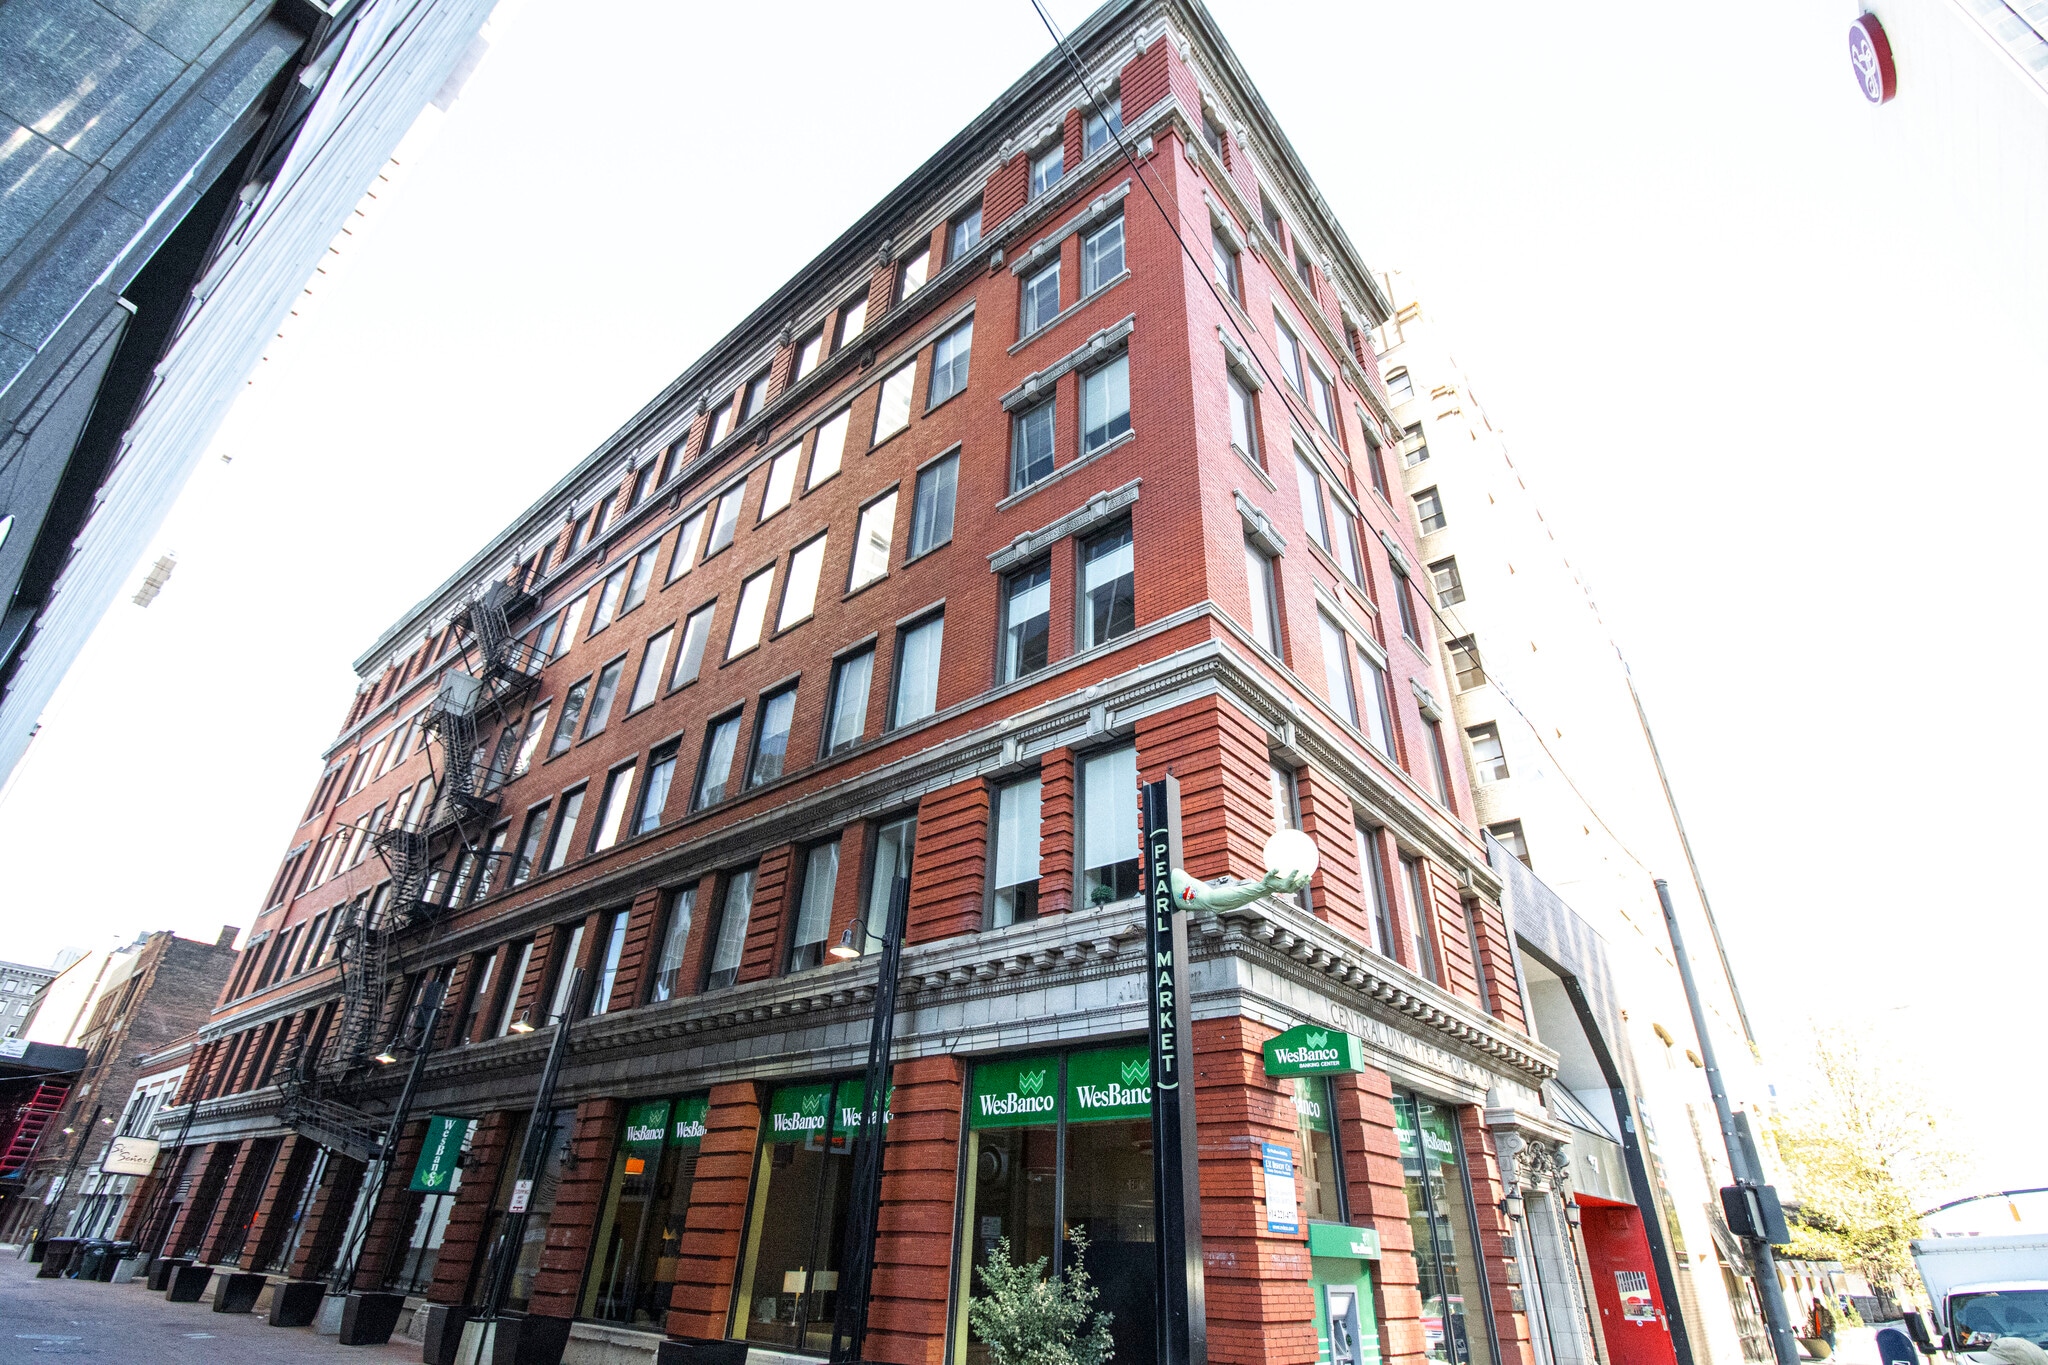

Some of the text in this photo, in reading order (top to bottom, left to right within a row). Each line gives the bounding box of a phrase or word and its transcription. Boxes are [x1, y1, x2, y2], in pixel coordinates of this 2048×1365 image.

[1155, 844, 1174, 1072] PEARL MARKET
[1331, 1004, 1384, 1043] CENTRAL
[1386, 1026, 1418, 1058] UNION
[1274, 1047, 1338, 1064] WesBanco
[980, 1092, 1054, 1115] WesBanco
[1076, 1083, 1151, 1108] WesBanc
[627, 1125, 664, 1141] WesBanco
[774, 1112, 824, 1131] WesBanco
[427, 1119, 456, 1187] WesBanco
